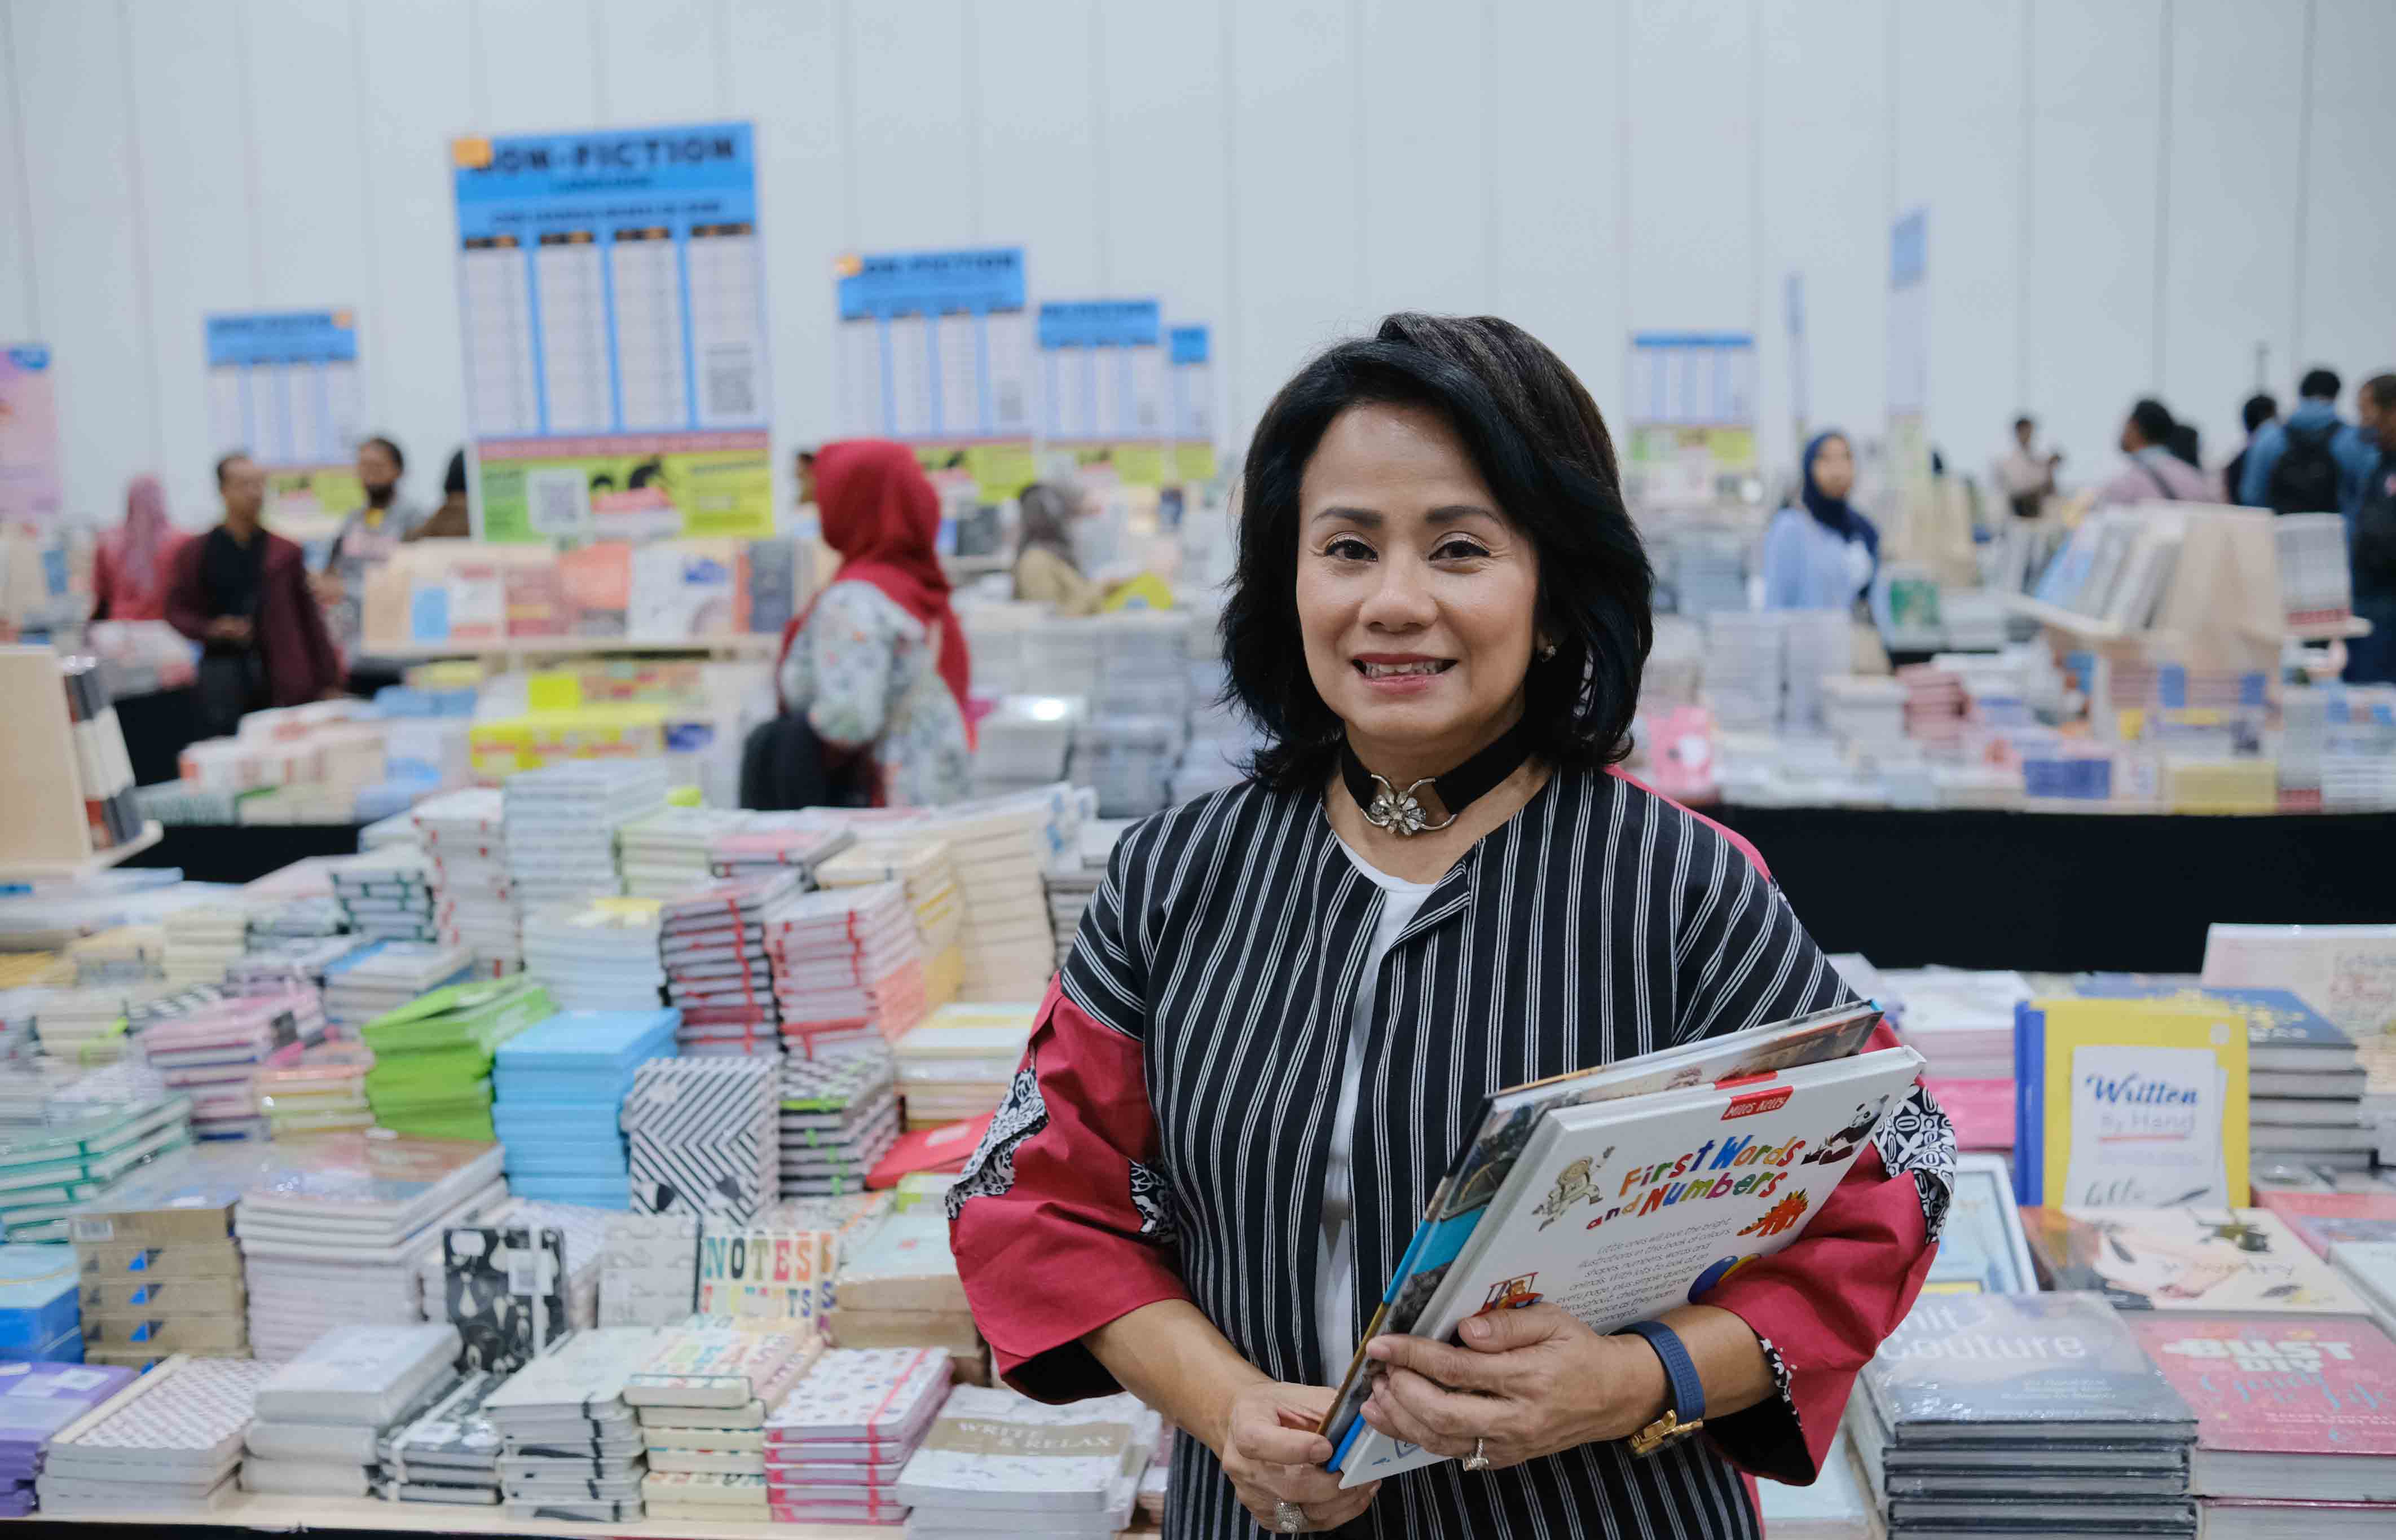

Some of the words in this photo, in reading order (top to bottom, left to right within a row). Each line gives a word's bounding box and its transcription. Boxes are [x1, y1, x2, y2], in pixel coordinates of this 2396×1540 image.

[475, 135, 735, 173] ON-FICTION
[2085, 1071, 2197, 1104] Written
[1619, 1139, 1715, 1198] First
[1708, 1134, 1806, 1170] Words
[1586, 1193, 1643, 1230] and
[1638, 1172, 1788, 1217] Numbers
[1702, 1217, 1732, 1230] bright
[704, 1237, 813, 1282] NOTES
[1877, 1332, 2086, 1361] Couture
[2176, 1338, 2355, 1360] BUST
[958, 1421, 1047, 1438] WRITE
[1022, 1434, 1115, 1449] RELAX
